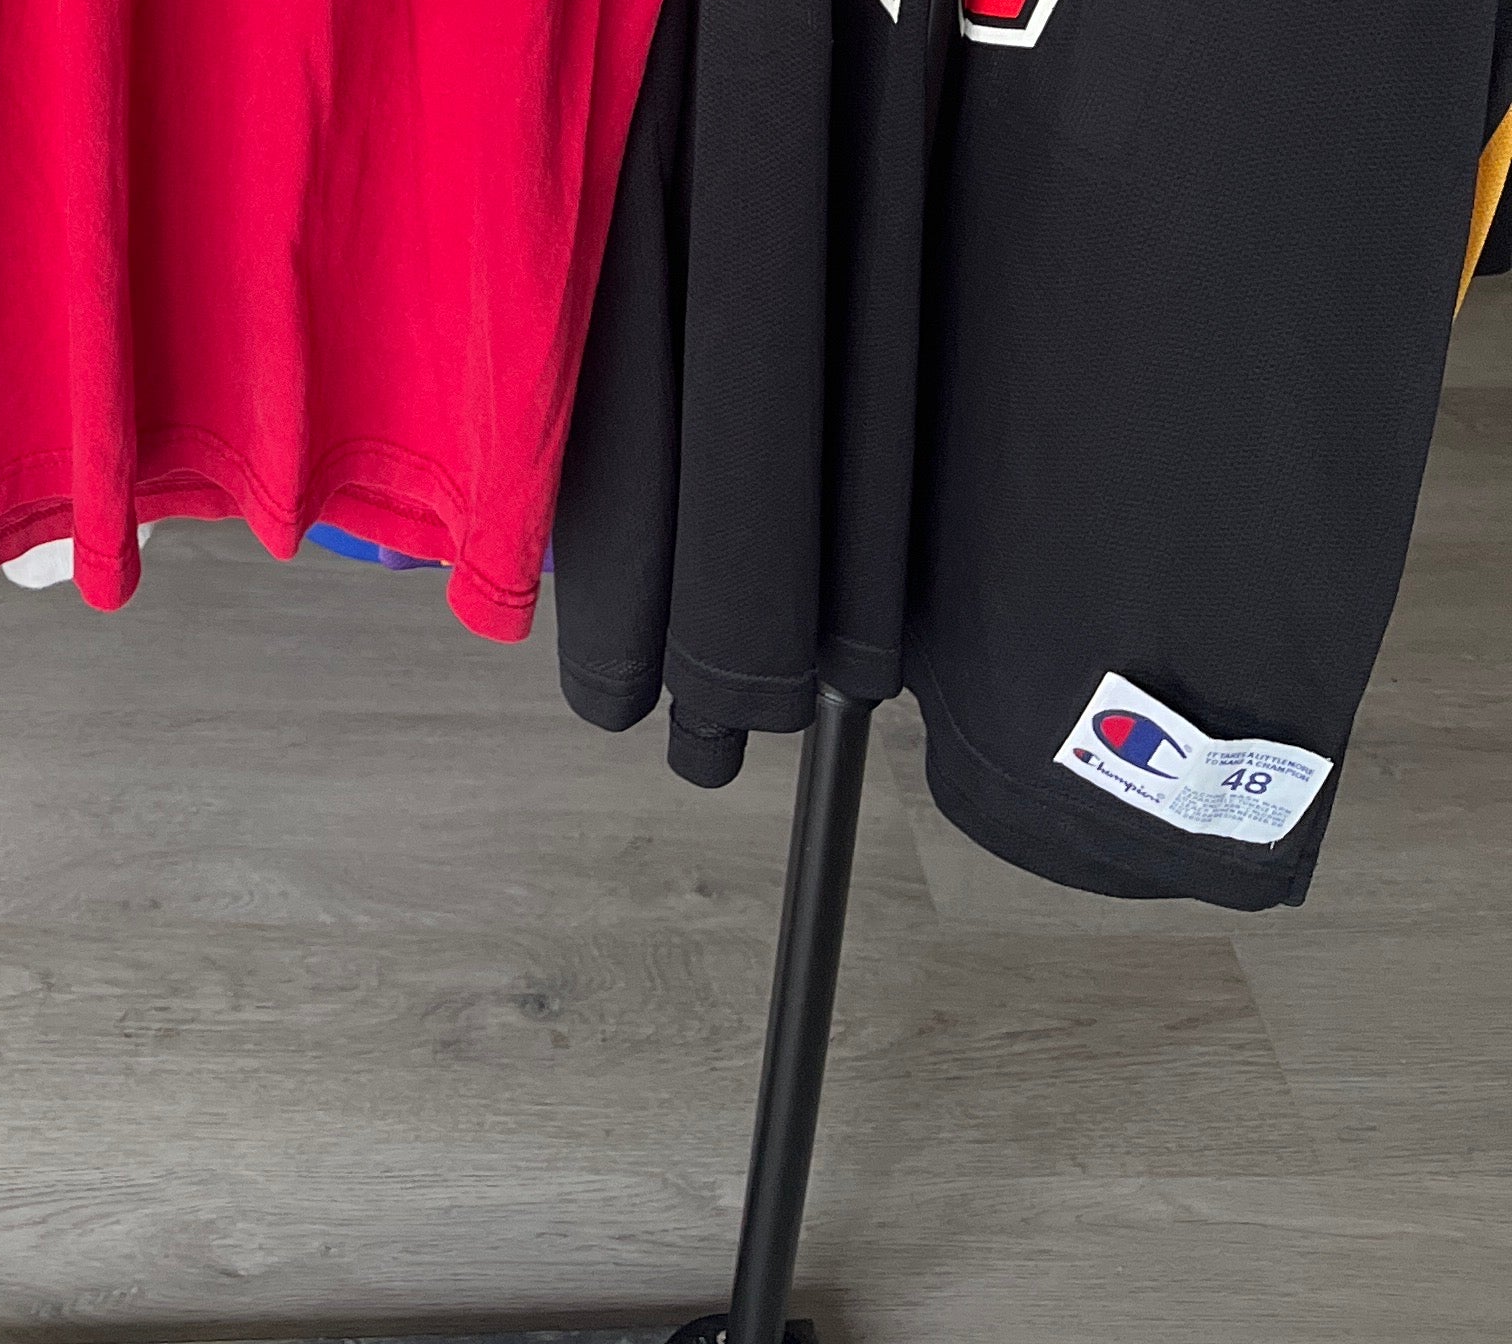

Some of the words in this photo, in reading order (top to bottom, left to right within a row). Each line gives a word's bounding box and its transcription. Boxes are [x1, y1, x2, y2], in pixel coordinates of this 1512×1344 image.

[1073, 748, 1160, 803] Champion
[1255, 752, 1288, 766] LITTLE
[1287, 759, 1316, 776] MORE
[1255, 760, 1310, 783] CHAMPION
[1221, 768, 1273, 795] 48
